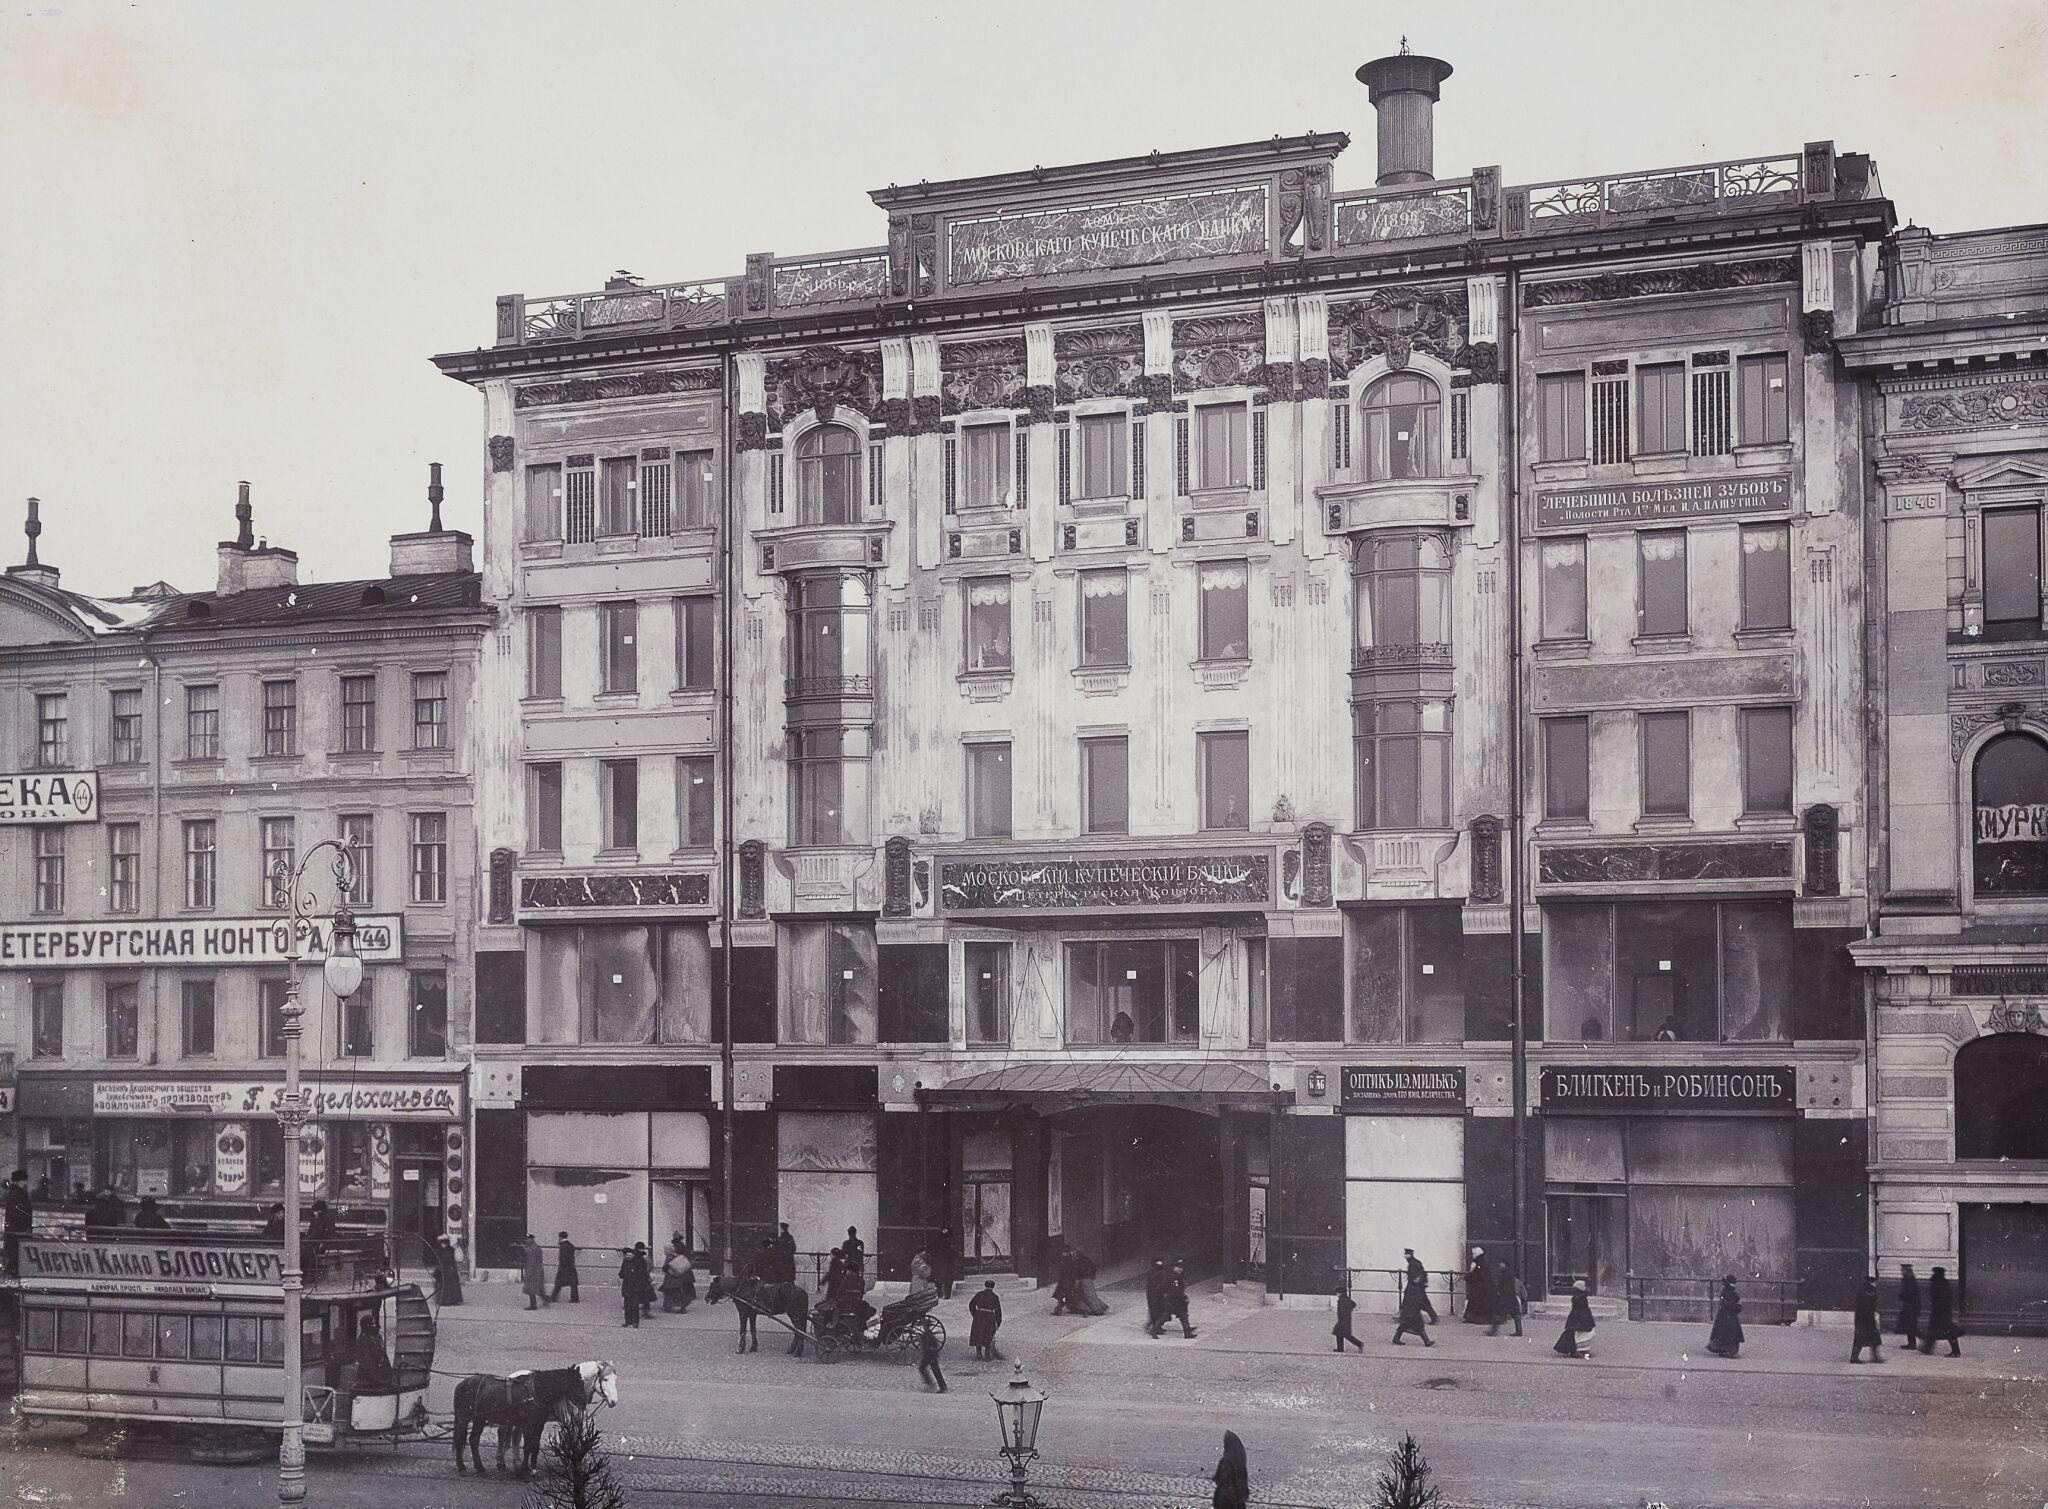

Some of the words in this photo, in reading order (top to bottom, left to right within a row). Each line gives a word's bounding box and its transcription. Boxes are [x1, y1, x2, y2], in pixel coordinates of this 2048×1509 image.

[963, 236, 1072, 264] МОСКОВСКАГО
[1081, 222, 1190, 251] КУПЕЧЕСКАГО
[1543, 492, 1627, 509] ЛЕЧЕБНИЦА
[1633, 484, 1712, 504] БОЛѢЗНЕЙ
[1718, 481, 1783, 497] ЗУБОВЪ
[1896, 495, 1936, 510] 1846
[0, 778, 71, 806] ЕКА
[76, 789, 88, 804] 44
[1979, 806, 2048, 839] МУРК
[962, 868, 1069, 887] МОСКОВСКІЙ
[1075, 863, 1180, 883] КУПЕЧЕСКІЙ
[2, 928, 195, 959] ЕТЕРБУРГСКАЯ
[362, 930, 386, 947] 44
[1350, 1073, 1393, 1089] ОПТИКЪ
[1556, 1074, 1650, 1098] БЛИГКЕНЪ
[1663, 1074, 1782, 1098] РОБИНСОНЪ
